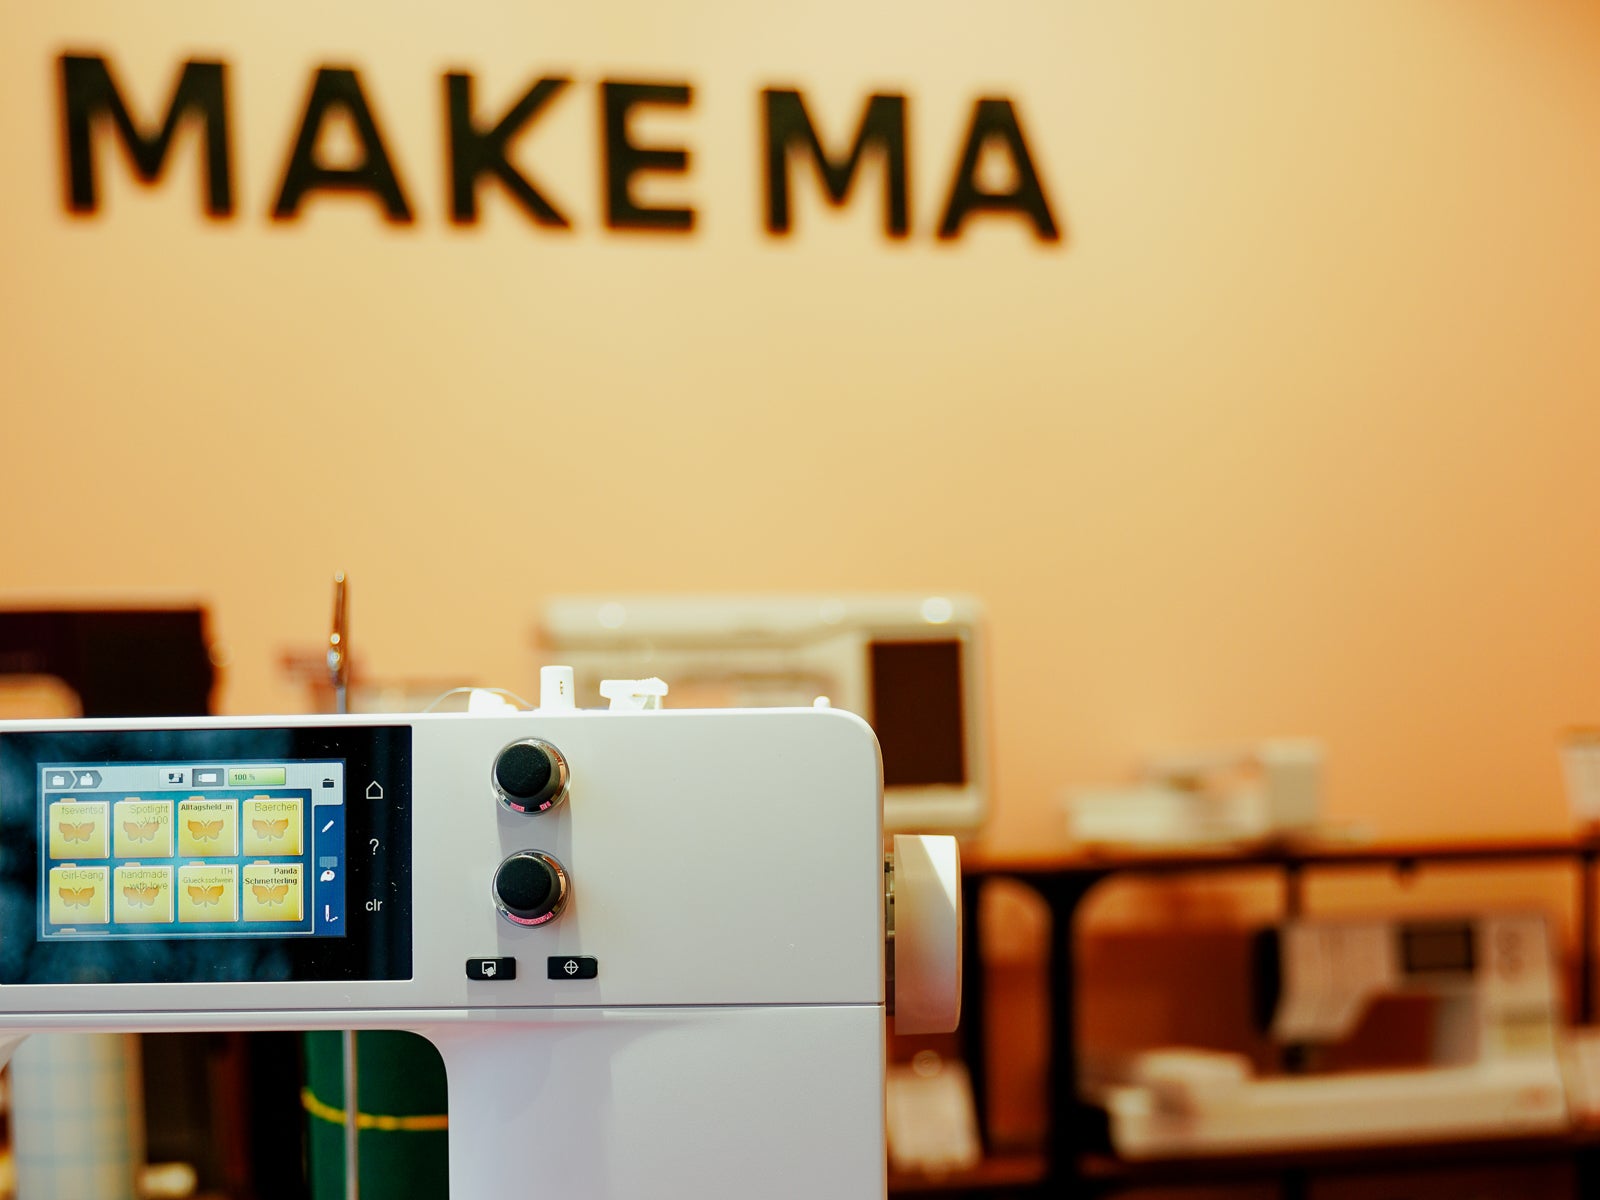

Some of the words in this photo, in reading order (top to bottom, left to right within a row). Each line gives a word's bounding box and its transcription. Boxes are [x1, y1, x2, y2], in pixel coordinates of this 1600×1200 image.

[56, 53, 695, 232] MAKE
[760, 86, 1062, 243] MA
[130, 804, 168, 815] Spotlight
[254, 802, 298, 812] Baerchen
[61, 870, 104, 882] Girl-Gang
[121, 870, 168, 879] handmade
[274, 867, 298, 875] Panda
[365, 898, 383, 911] clr
